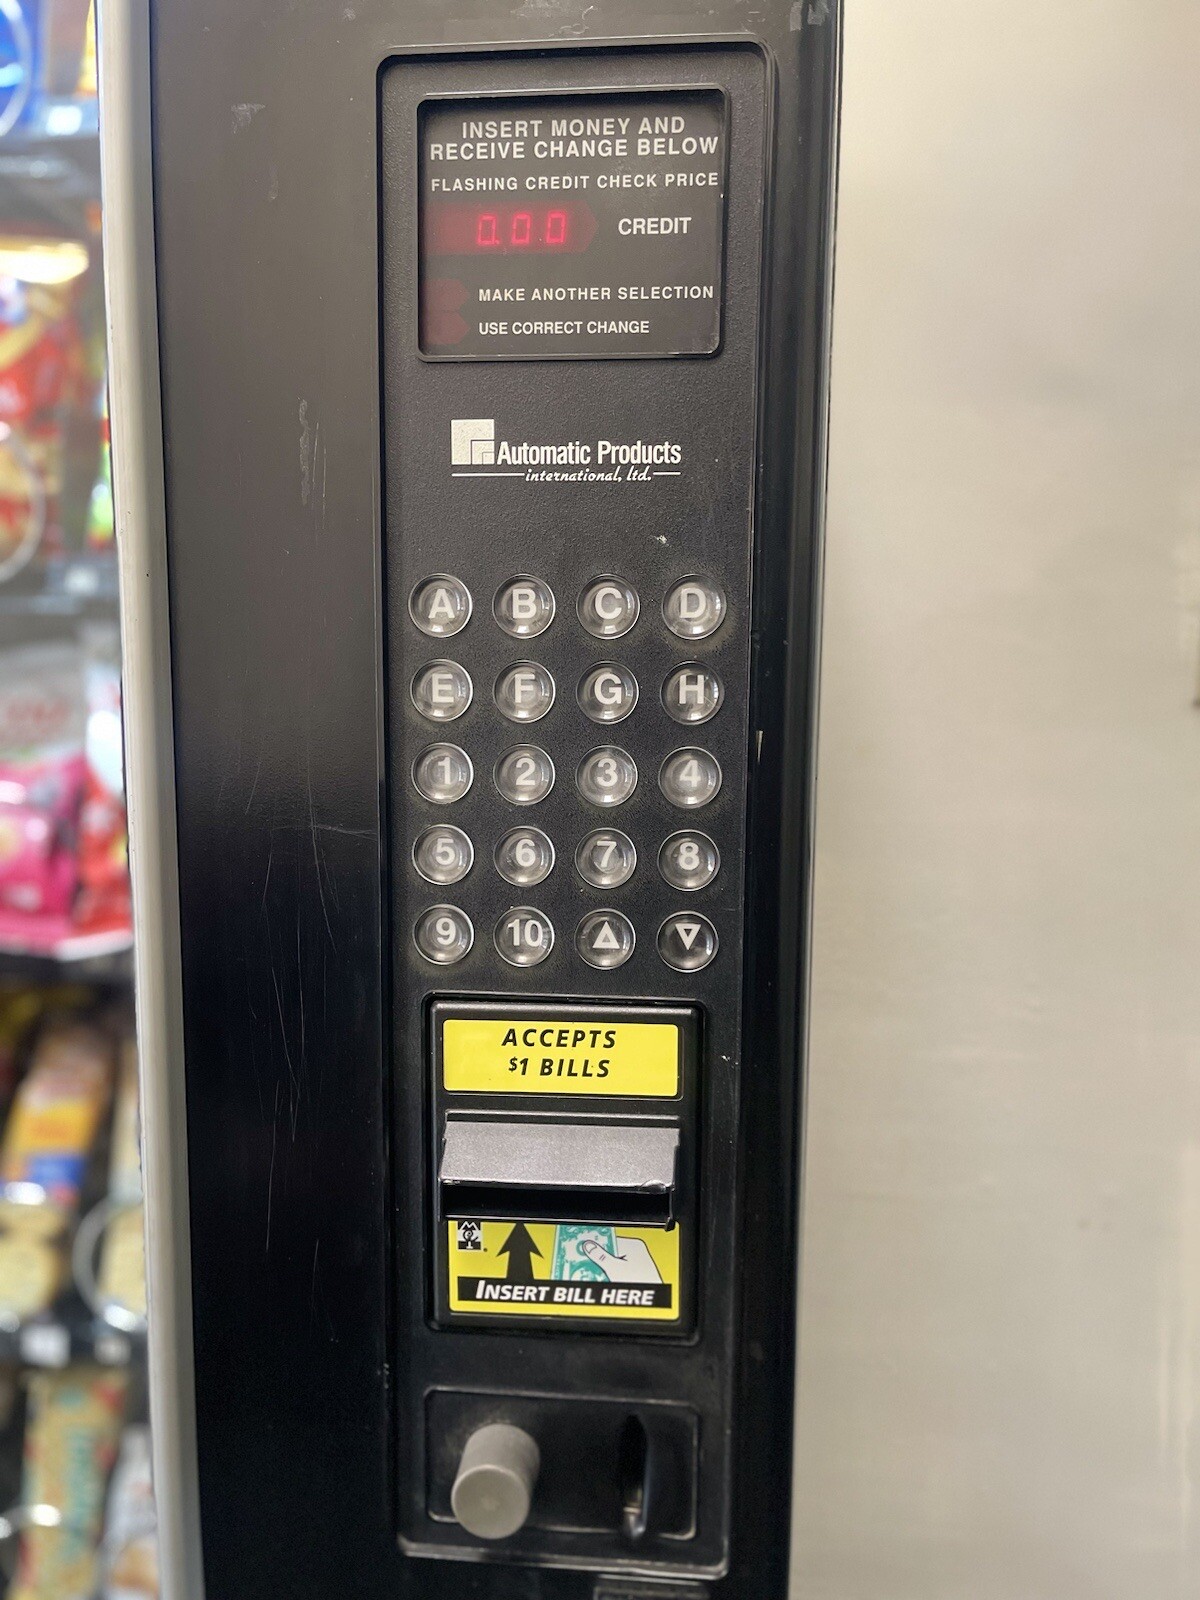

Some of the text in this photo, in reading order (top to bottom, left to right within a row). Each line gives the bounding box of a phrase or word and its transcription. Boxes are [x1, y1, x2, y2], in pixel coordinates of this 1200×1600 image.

[462, 116, 686, 139] INSERT MONEY AND
[430, 136, 718, 161] RECEIVE CHANGE BELOW
[431, 172, 718, 192] FLASHING CREDIT CHECK PRICE
[618, 217, 692, 235] CREDIT
[478, 286, 714, 302] MAKE ANOTHER SELECTION
[478, 320, 650, 335] USE CORRECT CHANGE
[497, 440, 682, 465] Automatic Products
[525, 465, 652, 483] international, ltd.
[428, 588, 455, 619] A
[512, 588, 537, 619] B
[594, 587, 622, 620] C
[679, 588, 706, 619] D
[431, 673, 454, 703] E
[514, 673, 536, 703] F
[594, 673, 622, 705] G
[678, 674, 705, 705] H
[437, 757, 451, 785] 1
[515, 757, 536, 786] 2
[597, 758, 618, 787] 3
[679, 760, 702, 787] 4
[435, 838, 456, 866] 5
[515, 838, 536, 867] 6
[596, 840, 617, 868] 7
[678, 842, 700, 870] 8
[435, 917, 456, 945] 9
[506, 919, 543, 947] 10
[501, 1028, 616, 1049] ACCEPTS
[508, 1056, 610, 1078] $1 BILLS
[475, 1280, 655, 1306] INSERT BILL HERE
